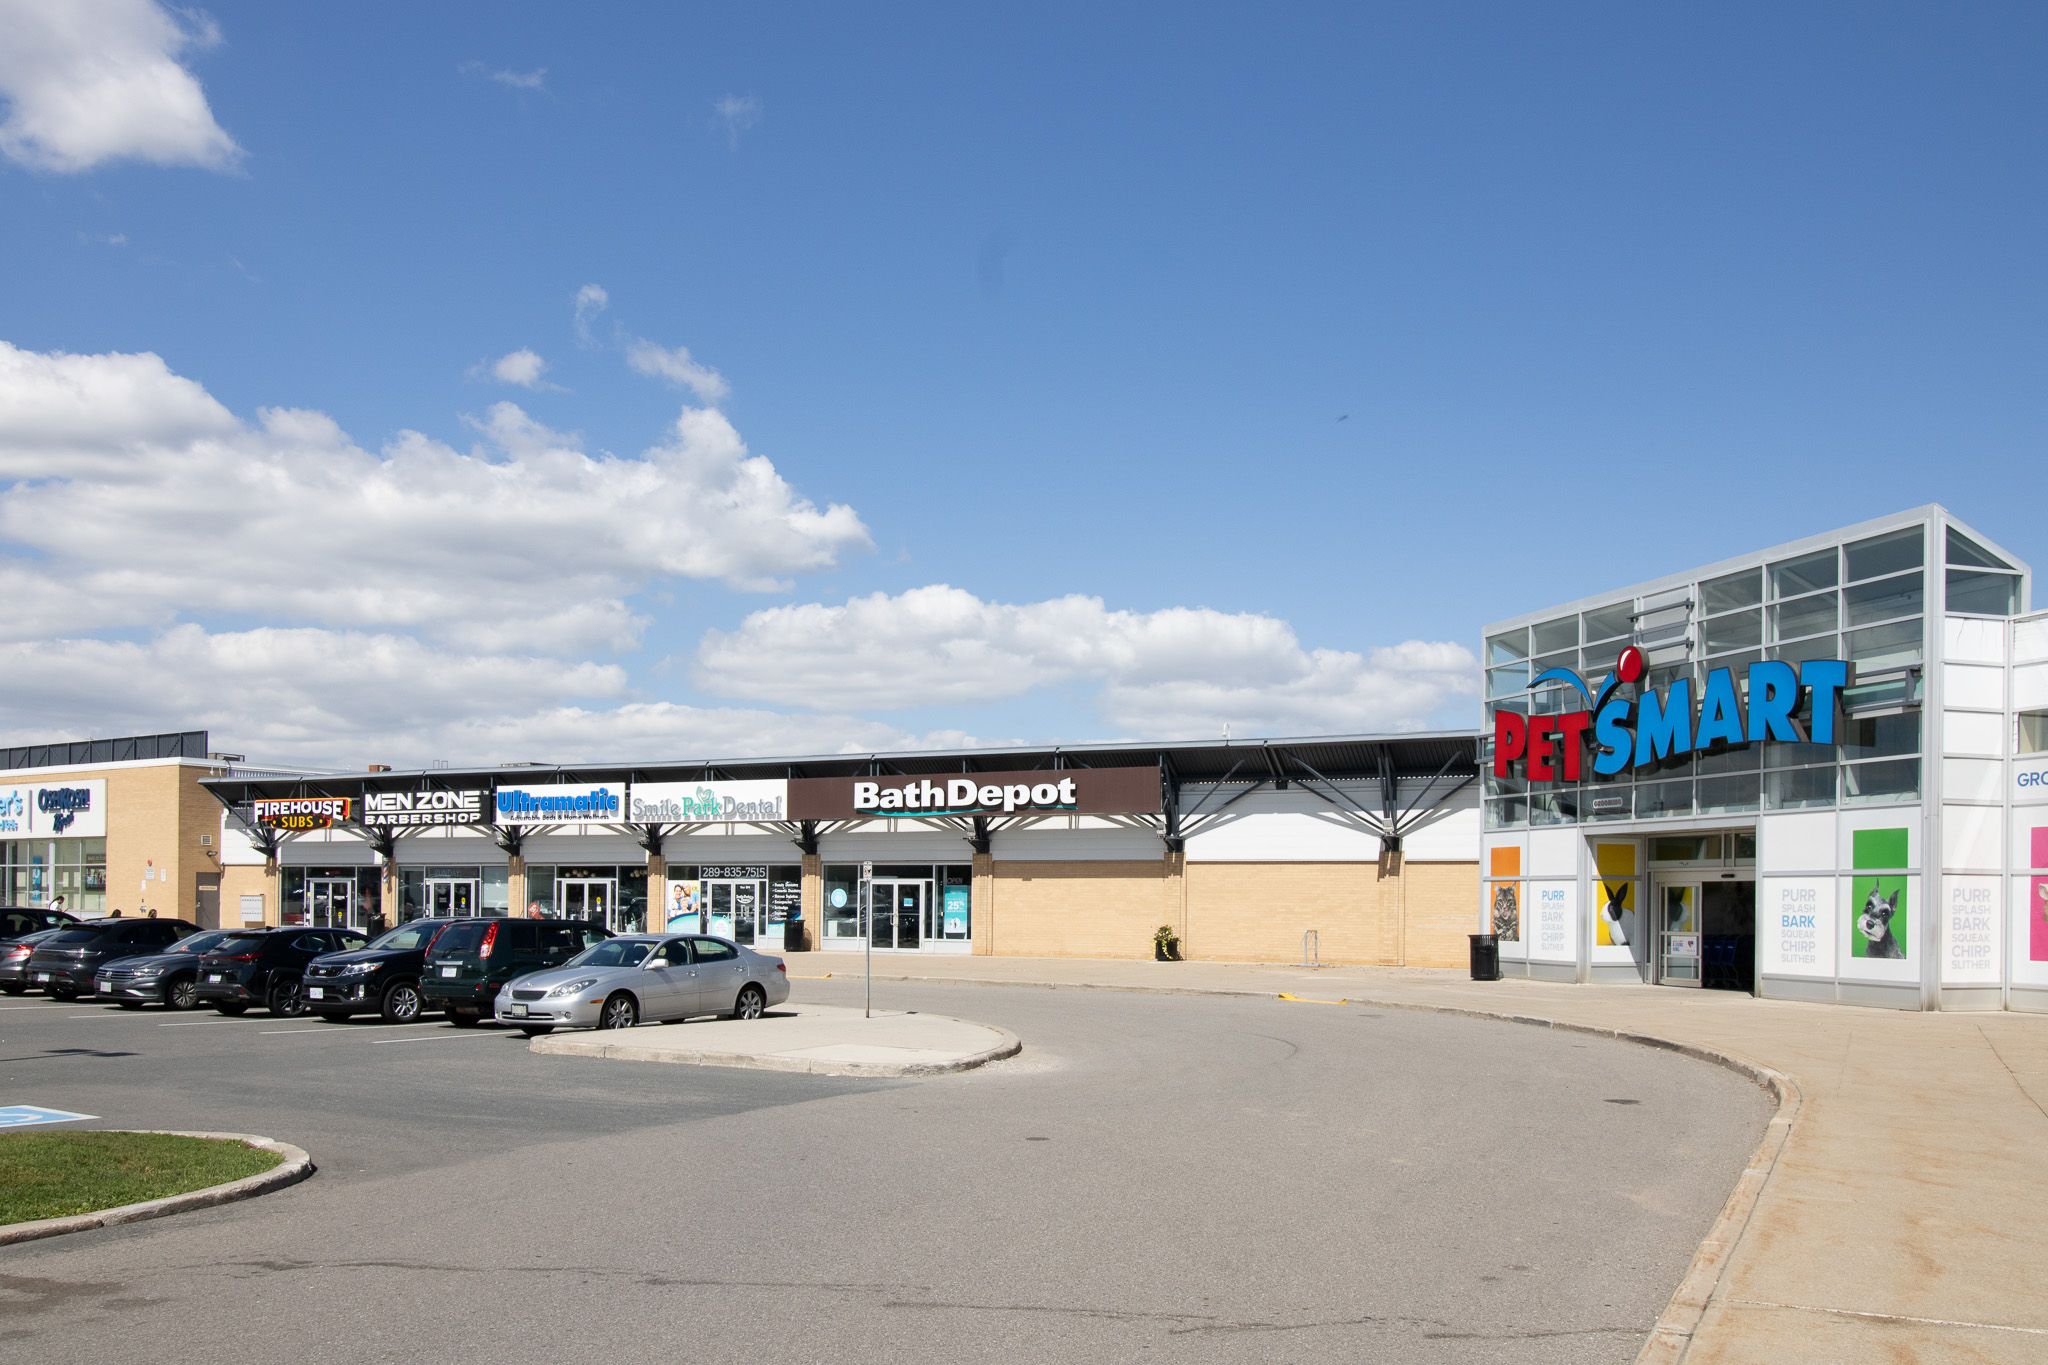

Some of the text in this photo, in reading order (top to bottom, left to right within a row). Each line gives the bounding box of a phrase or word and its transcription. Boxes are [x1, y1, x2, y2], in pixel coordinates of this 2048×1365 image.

[364, 792, 413, 811] MEN
[415, 790, 482, 809] ZONE
[498, 787, 619, 812] Ultramatic
[633, 795, 782, 816] Smile Park Dental
[254, 799, 344, 823] FIREHOUSE
[281, 815, 314, 828] SUBS
[364, 813, 482, 825] BARBERSHOP
[510, 813, 540, 822] Adjustable
[702, 867, 766, 878] 289-835-7515
[1541, 890, 1565, 901] PURR
[1781, 889, 1816, 902] PURR
[1952, 888, 1991, 902] PURR
[1781, 904, 1816, 913] SPLASH
[1952, 905, 1991, 915] SPLASH
[1541, 911, 1565, 922] BARK
[1781, 915, 1816, 928] BARK
[1952, 917, 1991, 931] BARK
[1781, 930, 1816, 939] SQUEAK
[1952, 933, 1991, 943] SQUEAK
[1781, 940, 1816, 952] CHIRP
[1952, 945, 1991, 958] CHIRP
[1781, 954, 1816, 964] SLITHER
[1952, 960, 1991, 970] SLITHER
